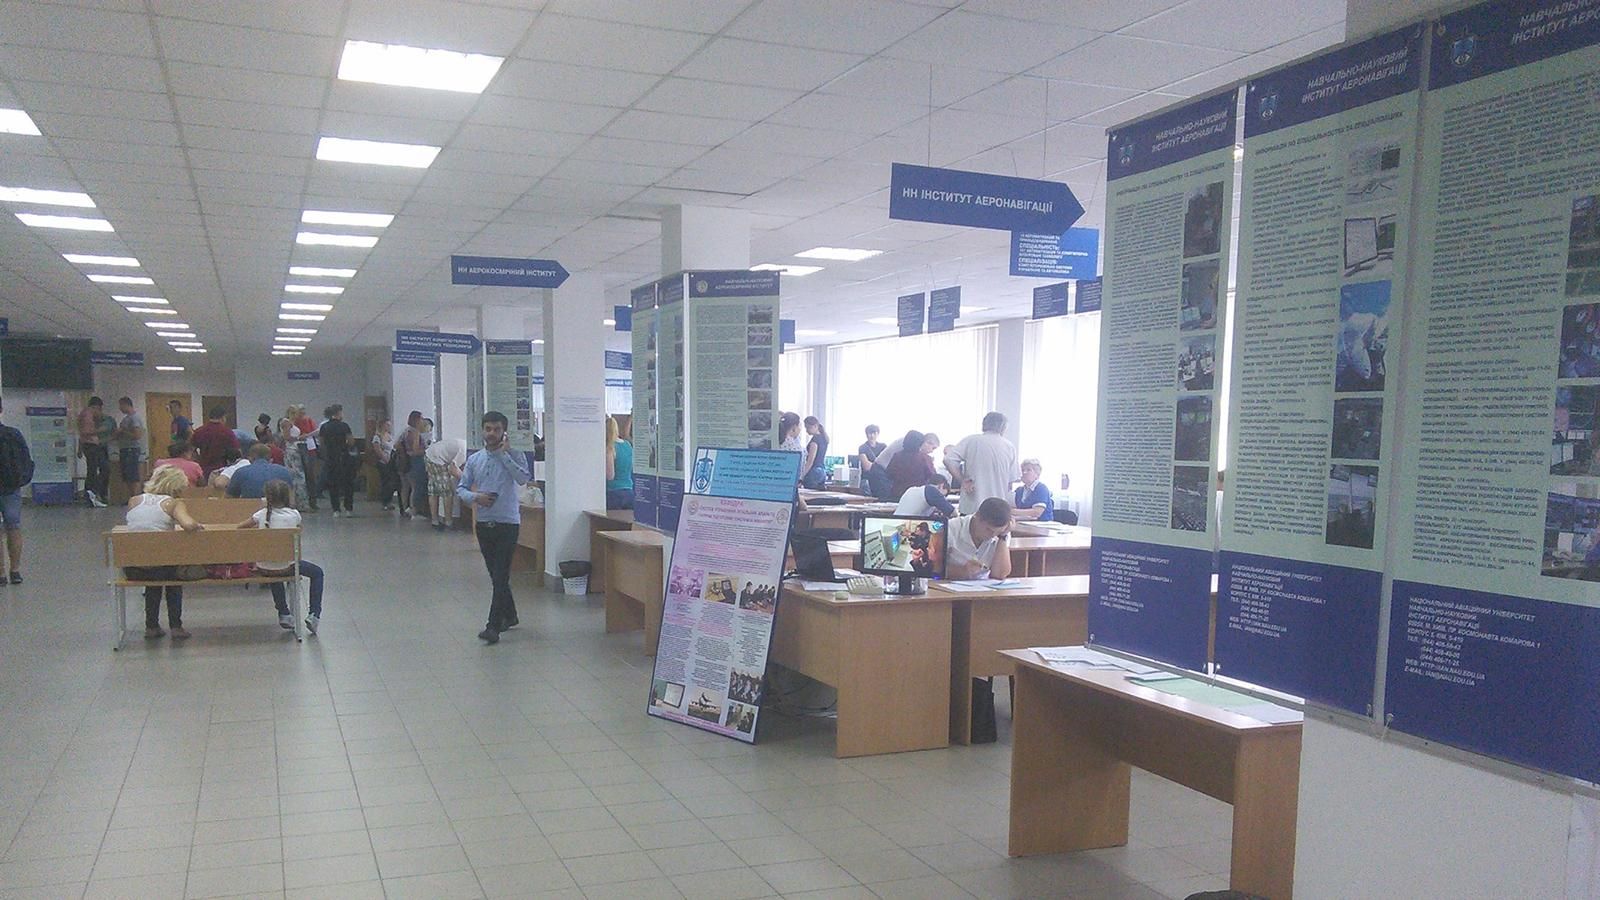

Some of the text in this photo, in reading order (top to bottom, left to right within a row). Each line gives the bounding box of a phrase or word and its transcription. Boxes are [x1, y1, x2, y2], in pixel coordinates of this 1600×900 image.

[1510, 18, 1568, 45] ІНСТИТУТ
[1308, 46, 1408, 89] НАВЧАЛЬНО-НАУКОВИЙ
[1302, 61, 1407, 104] ІНСТИТУТ АЕРОНАВІГАЦІЇ
[1152, 122, 1228, 152] ІНСТИТУТ АЕРОНАВІГАЦІЇ
[902, 188, 1053, 214] НН ІНСТИТУТ АЕРОНАВІГАЦІЇ
[470, 266, 524, 276] АЕРОКОСМІЧНИЙ
[1232, 564, 1265, 573] НАЦІОНАЛЬНИЙ
[1408, 612, 1480, 630] ІНСТИТУТ АЕРОНАВІГАЦІЇ
[1410, 597, 1536, 622] НАЦІОНАЛЬНИЙ АВІАЦІЙНИЙ УНІВЕРСИТЕТ
[1408, 628, 1430, 636] КОРПУС
[1458, 628, 1499, 641] КОСМОНАВТА
[1500, 636, 1535, 648] КОМАРОВА
